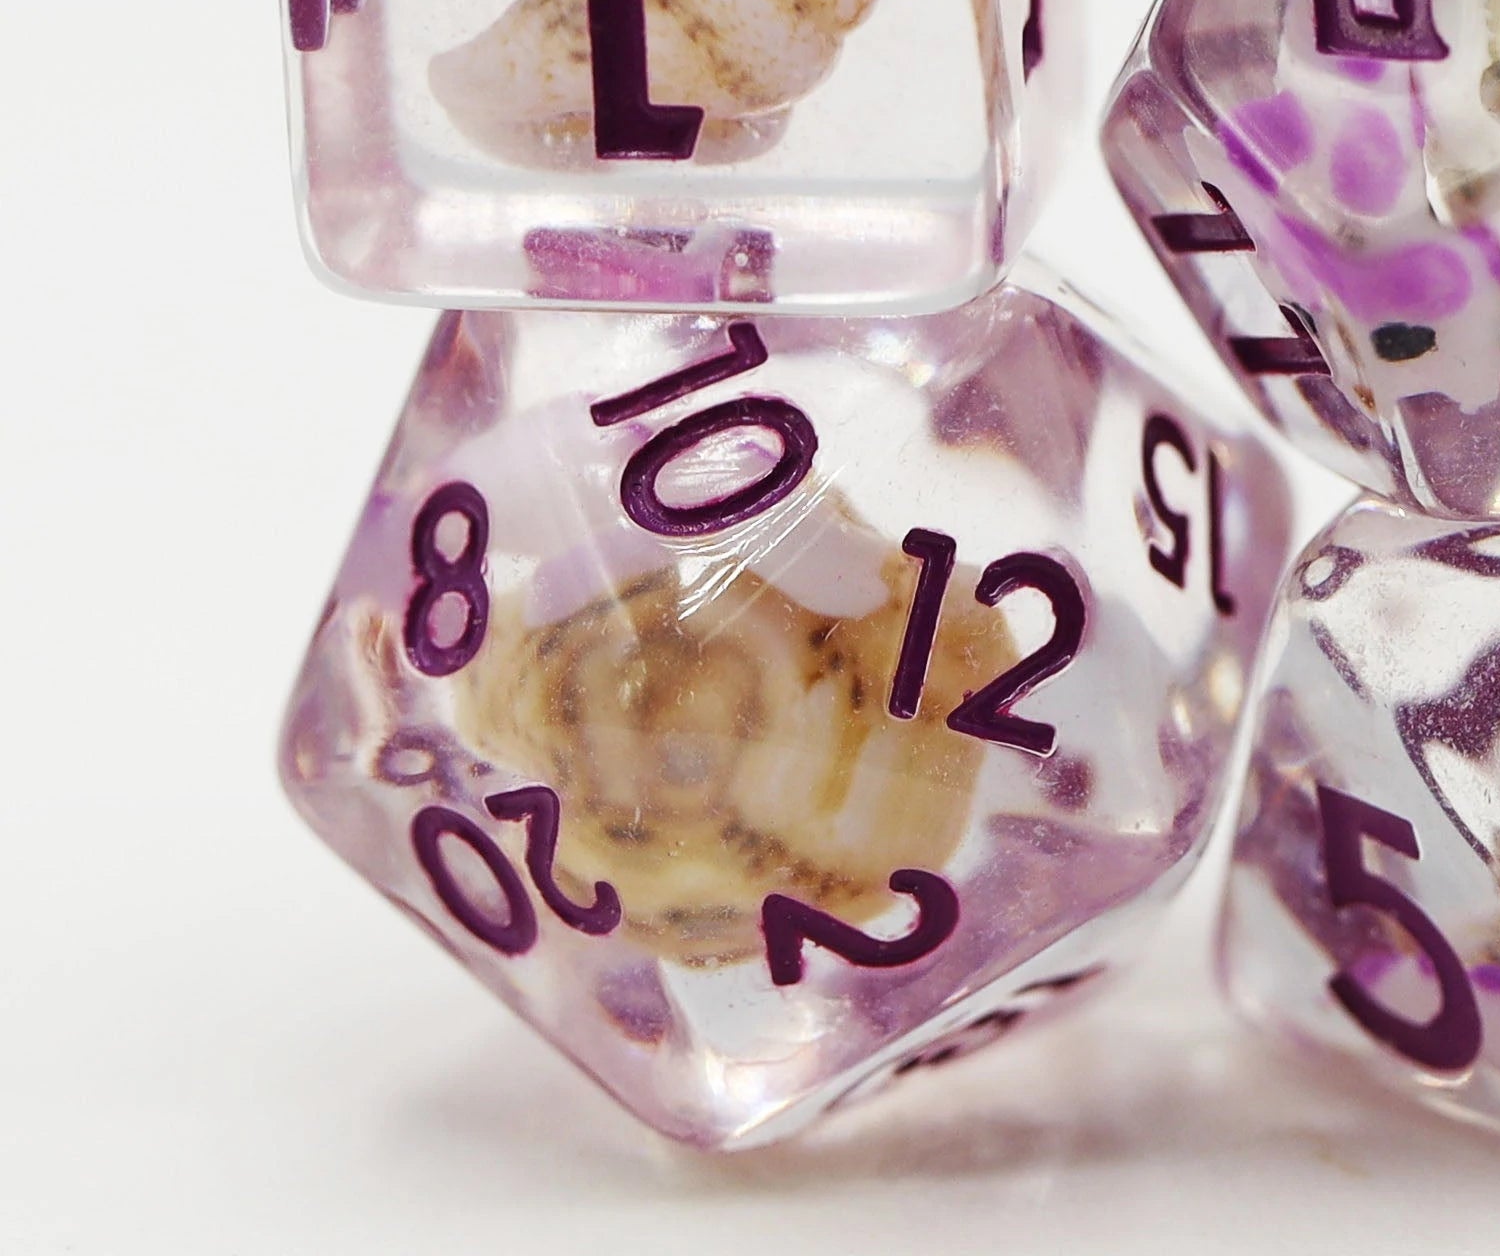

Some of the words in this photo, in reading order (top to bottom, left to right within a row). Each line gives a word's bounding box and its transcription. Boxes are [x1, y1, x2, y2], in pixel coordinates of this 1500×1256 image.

[590, 321, 819, 536] 10
[1142, 414, 1236, 616] 15
[403, 480, 490, 677] 8
[884, 527, 1088, 757] 12
[410, 784, 622, 956] 20
[763, 868, 960, 986] 2
[1316, 783, 1483, 1072] 5
